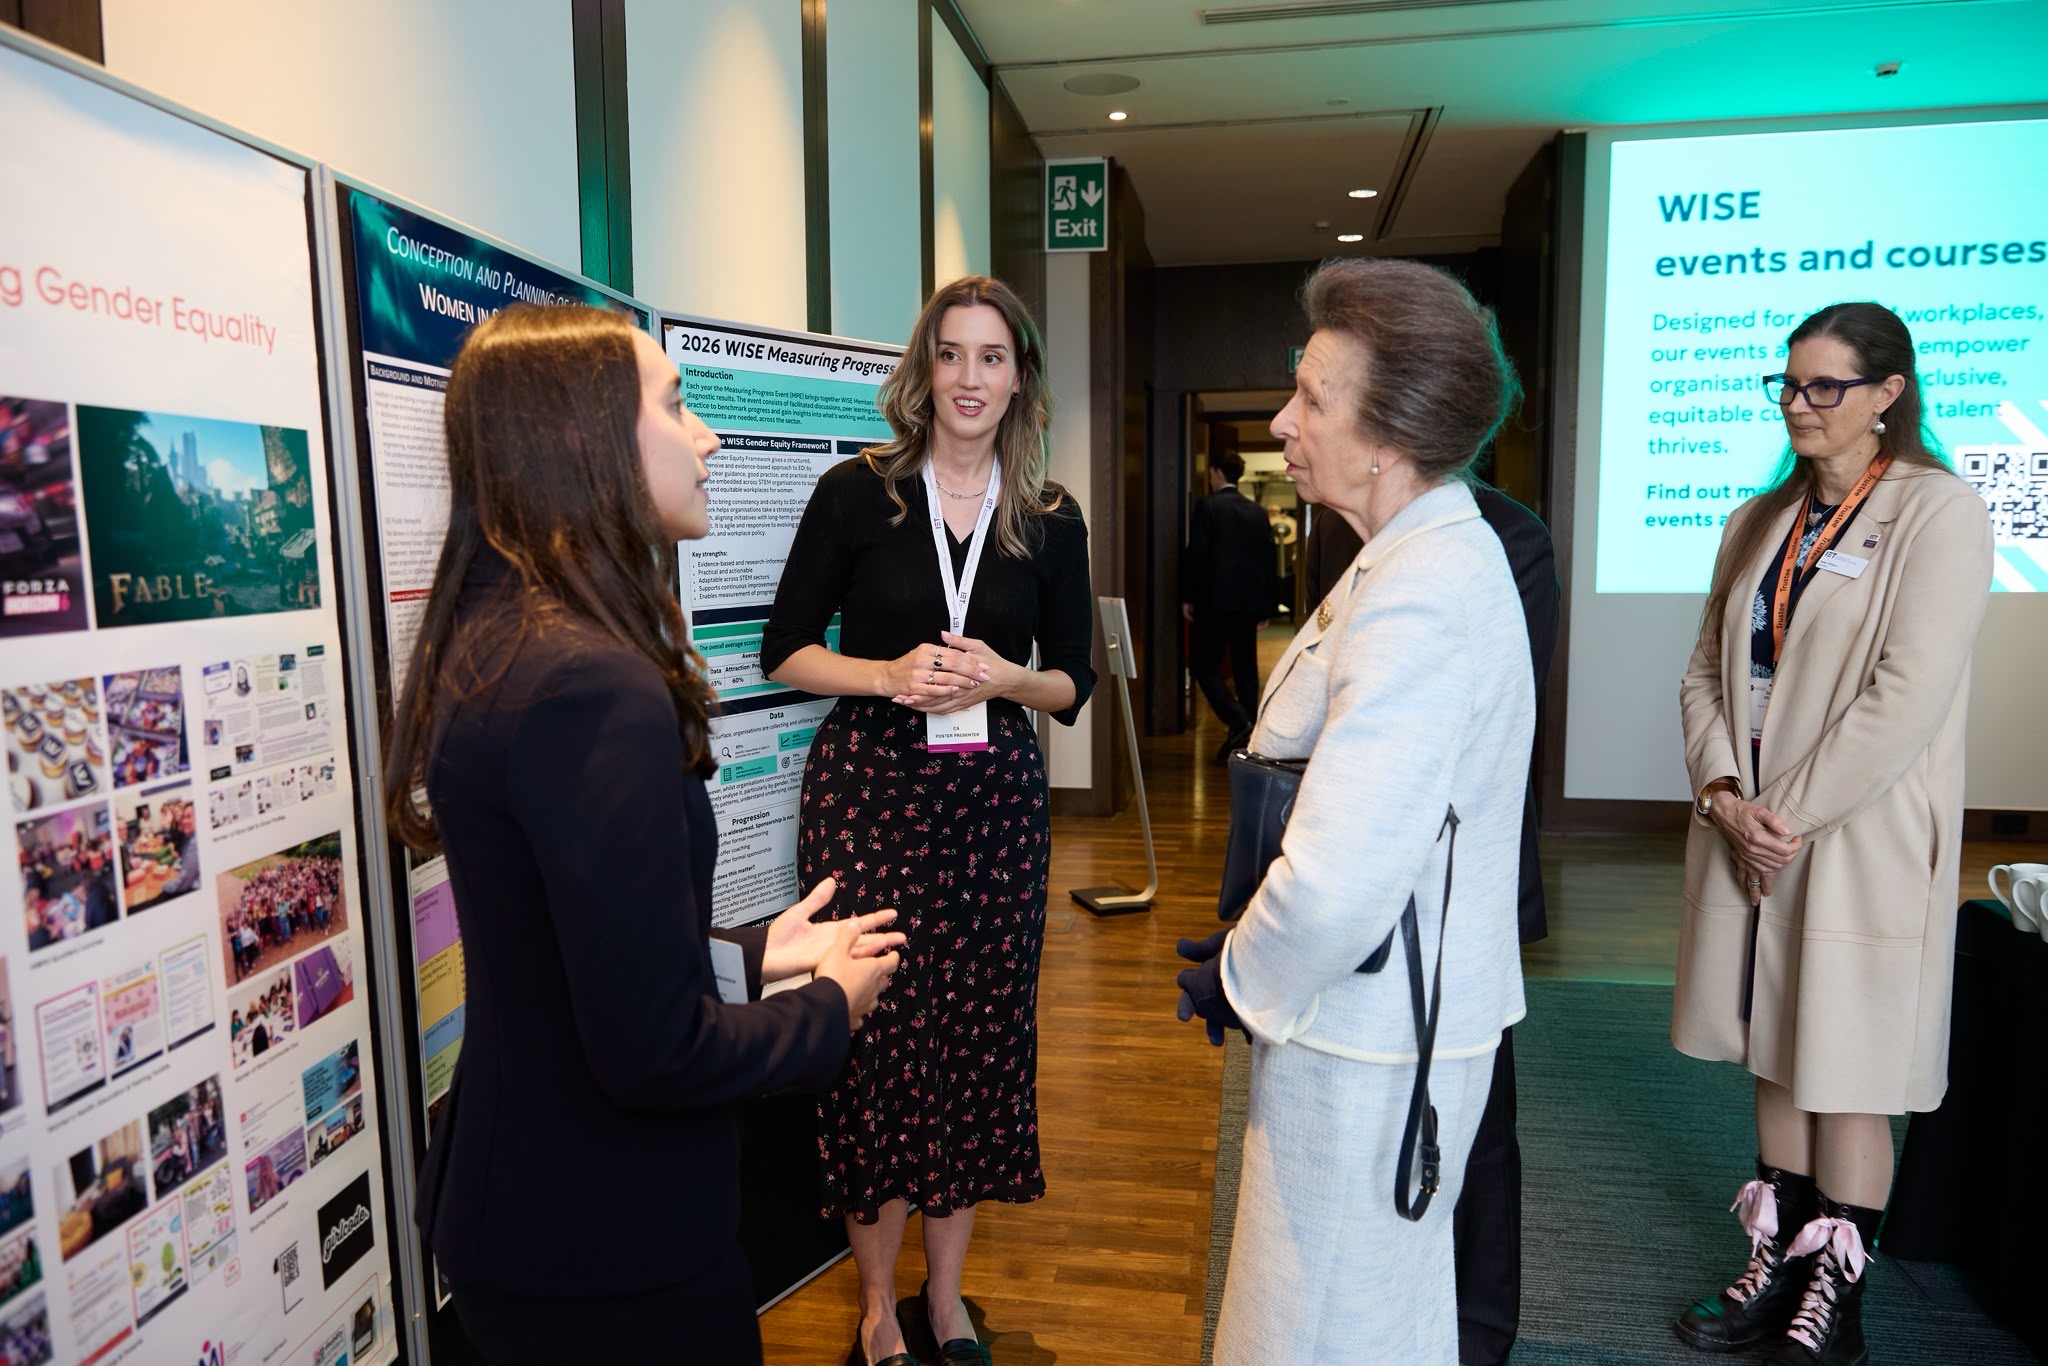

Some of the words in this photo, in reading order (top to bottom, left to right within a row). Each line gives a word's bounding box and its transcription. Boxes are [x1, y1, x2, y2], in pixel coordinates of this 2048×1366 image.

[1659, 191, 1760, 222] WISE
[1056, 218, 1097, 237] Exit
[387, 226, 473, 280] CONCEPTION
[475, 265, 500, 290] AND
[1655, 246, 1787, 276] events
[1799, 241, 1874, 272] and
[1886, 240, 2046, 268] courses
[36, 265, 163, 326] Gender
[173, 296, 276, 355] Equality
[419, 282, 474, 324] WOMEN
[1653, 309, 1755, 334] Designed
[1764, 305, 1795, 328] for
[1905, 303, 2044, 325] workplaces,
[682, 334, 720, 354] 2026
[725, 340, 764, 359] WISE
[768, 346, 839, 372] Measuring
[842, 356, 895, 376] Progress
[1652, 349, 1688, 361] our
[1694, 344, 1767, 360] events
[1919, 338, 2030, 358] empower
[686, 367, 733, 380] Introduction
[1650, 374, 1761, 397] organisati
[1922, 368, 2007, 386] clusive,
[686, 391, 715, 401] diagnostic
[762, 398, 782, 406] consists
[790, 400, 813, 409] facilitated
[814, 403, 841, 412] discussions,
[854, 406, 871, 415] learning
[701, 384, 713, 392] year
[724, 385, 751, 396] Measuring
[752, 388, 774, 397] Progress
[805, 393, 819, 402] brings
[820, 395, 840, 403] together
[841, 396, 852, 404] WISE
[854, 397, 874, 406] Members
[717, 403, 747, 412] benchmark
[748, 407, 770, 415] progress
[781, 409, 792, 417] gain
[793, 410, 811, 418] insights
[822, 411, 837, 419] what's
[838, 413, 856, 422] working
[857, 414, 867, 422] well,
[1649, 405, 1752, 427] equitable
[726, 437, 744, 446] WISE
[745, 439, 770, 447] Gender
[770, 440, 791, 450] Equity
[791, 441, 828, 450] Framework?
[1649, 438, 1728, 454] thrives.
[1647, 484, 1690, 499] Find
[1697, 486, 1731, 498] out
[1855, 474, 1877, 496] Trustee
[1646, 513, 1713, 527] events
[1832, 505, 1852, 528] Trustee
[692, 551, 701, 559] Key
[702, 550, 727, 558] strengths:
[1788, 537, 1799, 560] Trustee
[1811, 537, 1831, 561] Trustee
[1780, 568, 1791, 592] Trustee
[3, 578, 70, 594] FORZA
[109, 573, 211, 614] FABLE
[1777, 603, 1785, 629] Trustee
[770, 712, 784, 720] Data
[728, 824, 754, 836] widespread.
[755, 817, 782, 830] Sponsorship
[732, 811, 770, 825] Progression
[717, 873, 728, 881] does
[738, 864, 756, 874] matter?
